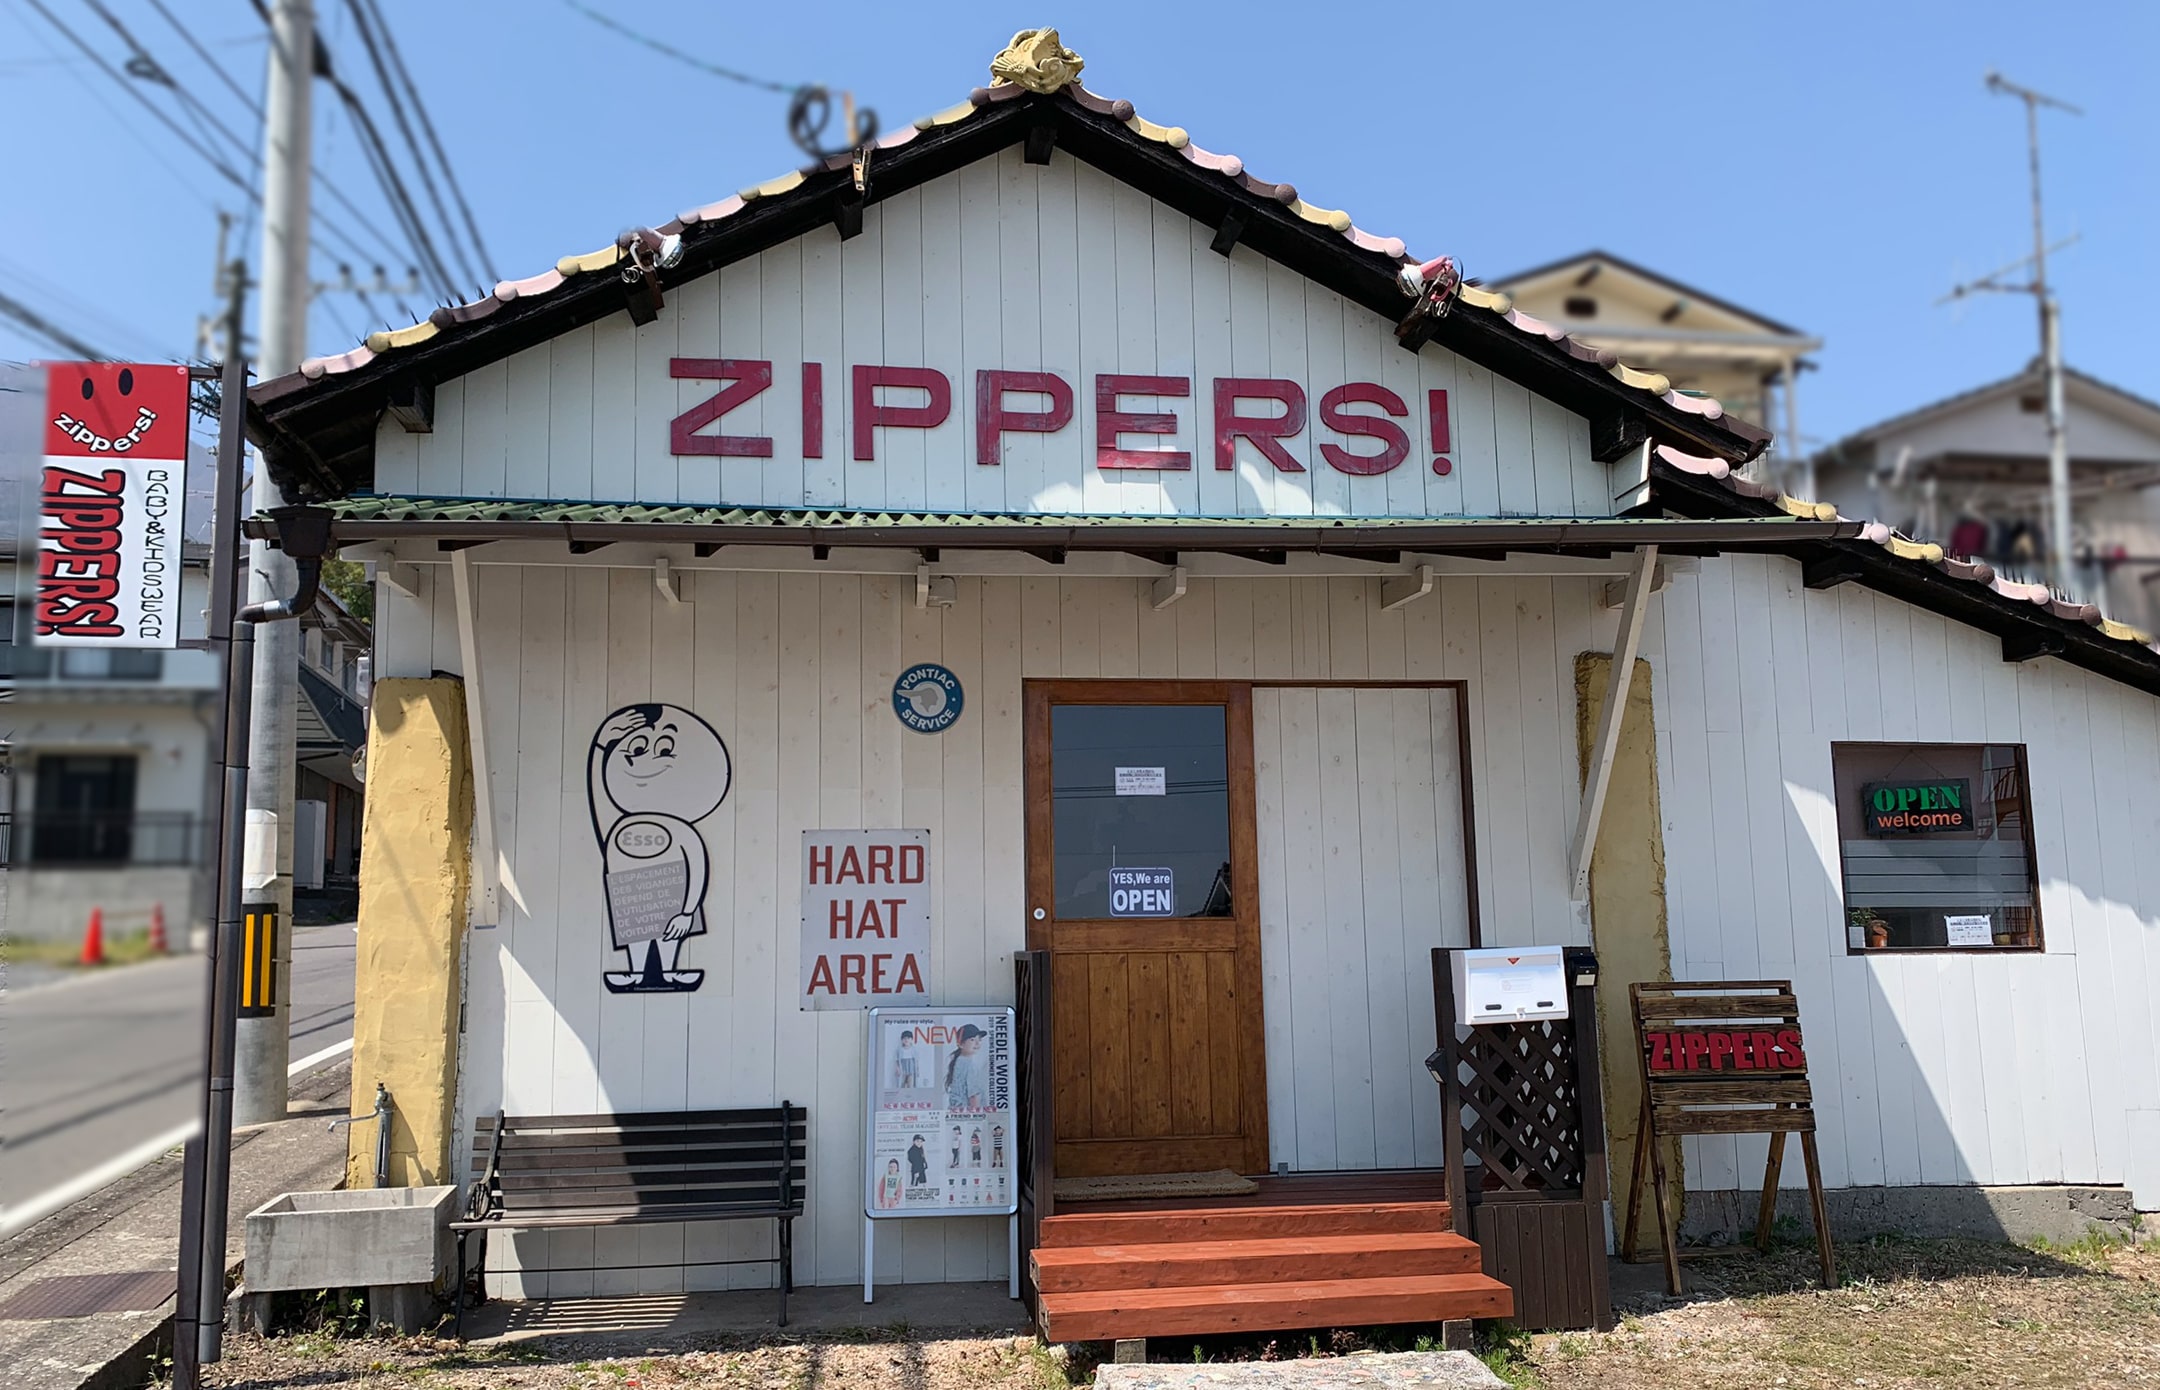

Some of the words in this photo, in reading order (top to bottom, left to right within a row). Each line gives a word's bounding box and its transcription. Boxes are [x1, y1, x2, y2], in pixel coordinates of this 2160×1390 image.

[54, 406, 158, 452] zippers!
[669, 356, 1454, 477] ZIPPERS!
[35, 467, 126, 637] ZIPPERS!
[901, 668, 955, 690] PONTIAC
[901, 708, 956, 730] SERVICE
[1873, 785, 1961, 812] OPEN
[1877, 811, 1963, 828] welcome
[621, 831, 666, 847] Esso
[809, 845, 924, 885] HARD
[1153, 874, 1170, 884] are
[658, 889, 671, 898] DE
[1112, 889, 1171, 912] OPEN
[618, 919, 631, 928] DE
[635, 911, 665, 924] VOTRE
[619, 923, 660, 938] VOITURE
[829, 899, 907, 939] HAT
[807, 953, 925, 995] AREA
[913, 1026, 965, 1045] NEW
[995, 1016, 1008, 1060] NEEDLE
[1647, 1030, 1804, 1070] ZIPPERS
[996, 1064, 1008, 1109] WORKS
